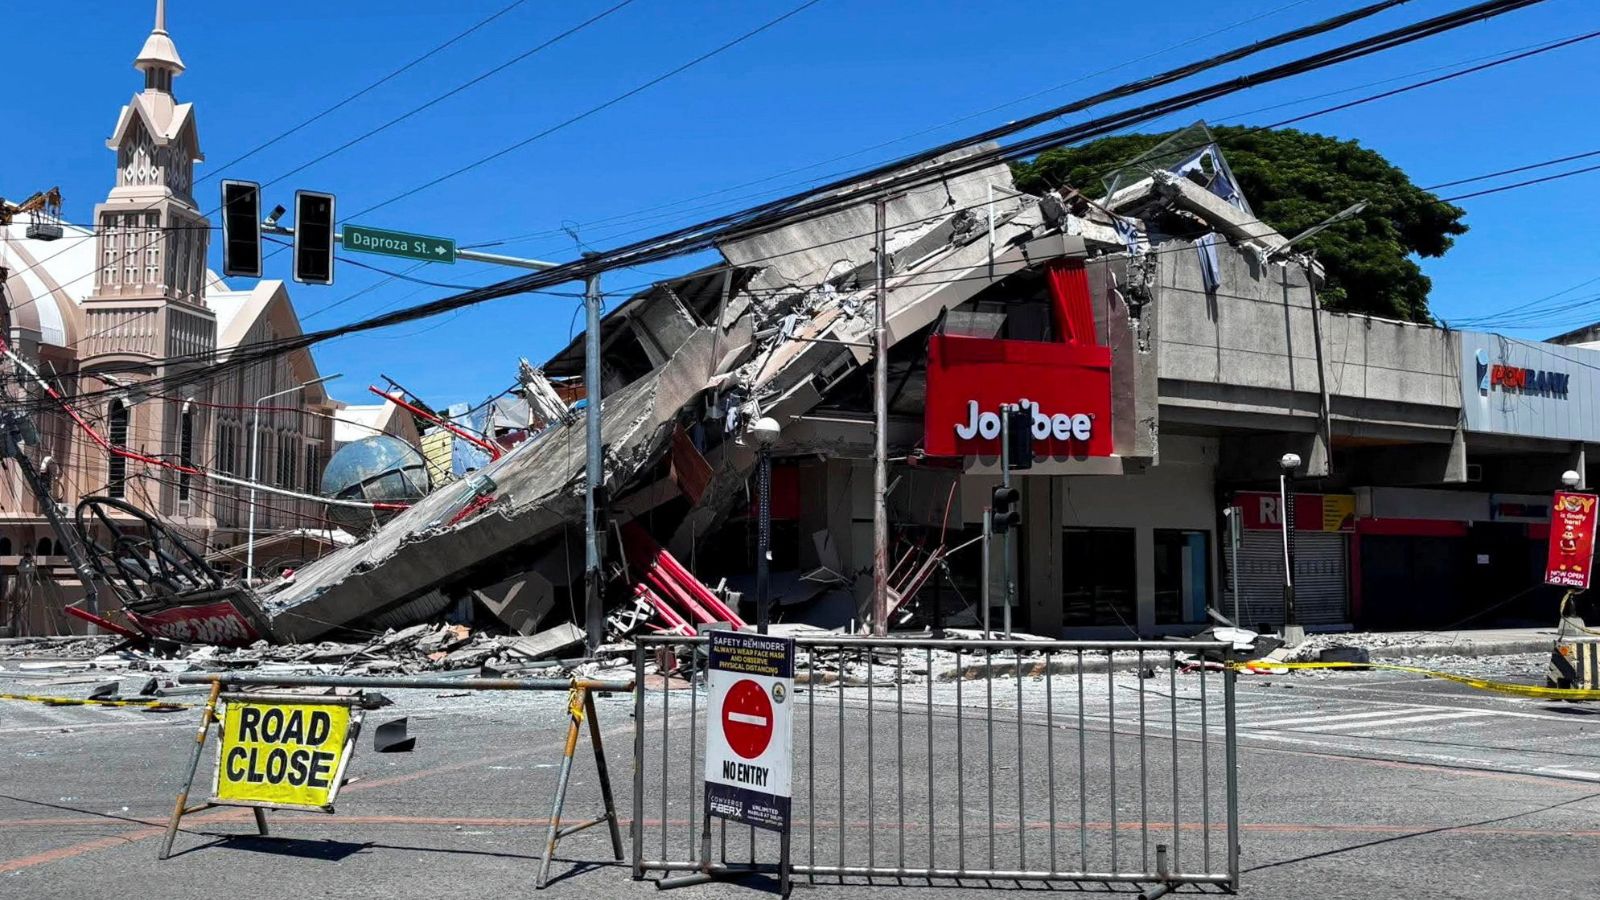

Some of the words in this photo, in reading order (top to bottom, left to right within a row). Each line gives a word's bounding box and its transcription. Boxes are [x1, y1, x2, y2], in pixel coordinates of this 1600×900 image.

[353, 232, 408, 251] Daproza
[414, 241, 430, 254] St.
[954, 397, 1092, 441] Jobee
[1550, 570, 1566, 578] NOW
[1562, 578, 1584, 586] Plaza
[713, 637, 741, 645] SAFETY
[743, 639, 785, 651] REMINDERS
[713, 646, 736, 654] ALWAYS
[737, 648, 753, 656] WEAR
[754, 650, 768, 658] FACE
[769, 651, 785, 659] MASK
[743, 656, 768, 665] OBSERVE
[719, 661, 745, 670] PHYSICAL
[745, 663, 778, 674] DISTANCING
[238, 707, 331, 746] ROAD
[226, 746, 335, 788] CLOSE
[723, 760, 736, 780] NO
[737, 763, 769, 787] ENTRY
[710, 795, 743, 808] CONVERGE
